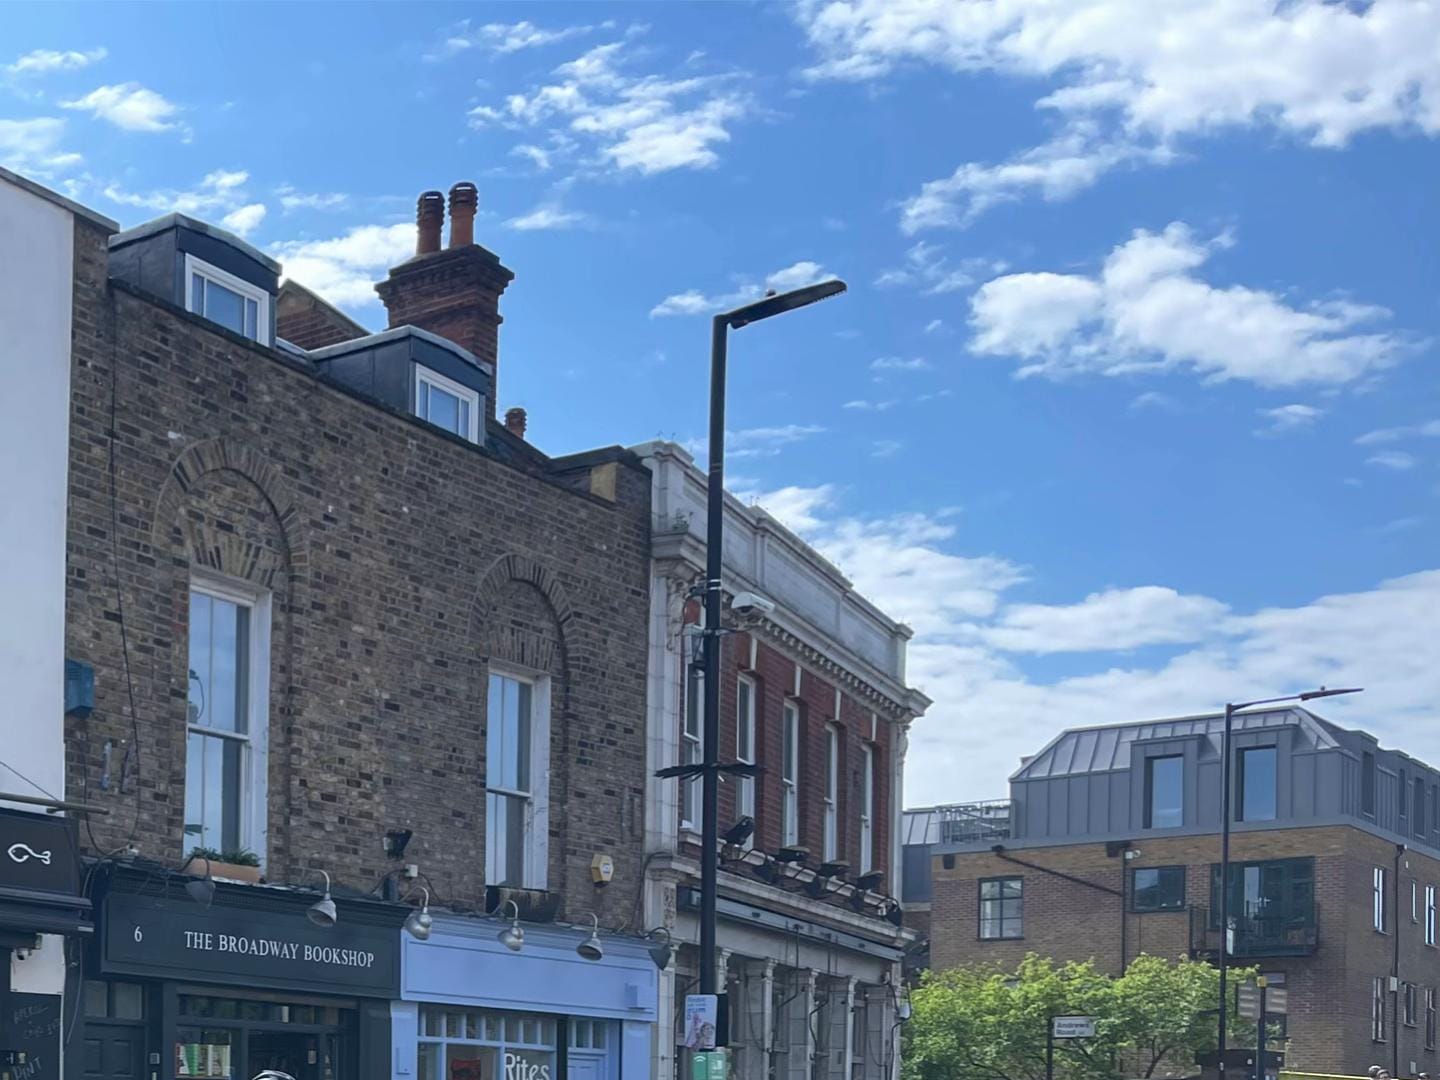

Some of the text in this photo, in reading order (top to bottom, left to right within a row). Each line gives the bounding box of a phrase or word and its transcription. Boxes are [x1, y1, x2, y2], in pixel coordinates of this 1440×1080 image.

[134, 925, 143, 943] 6
[183, 930, 374, 968] THE BROADWAY BOOKSHOP
